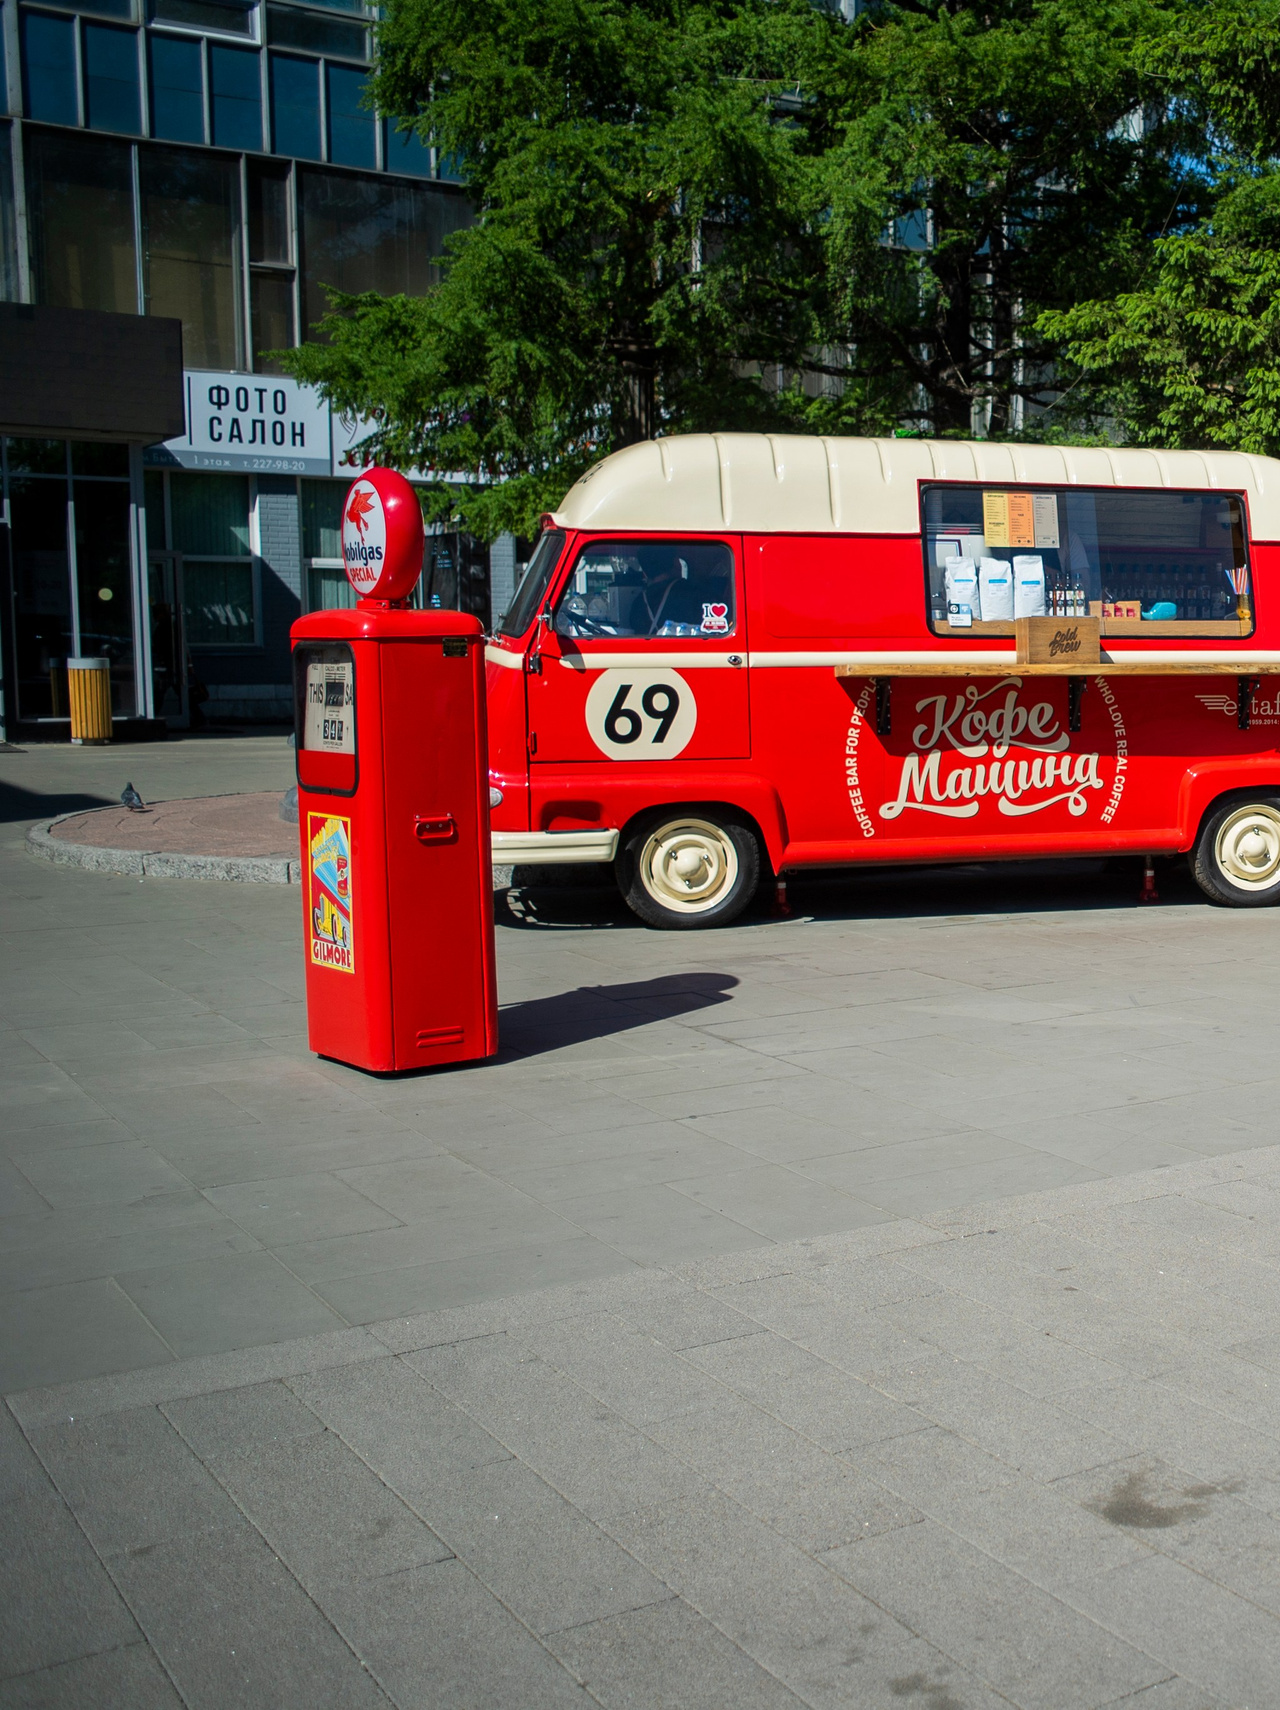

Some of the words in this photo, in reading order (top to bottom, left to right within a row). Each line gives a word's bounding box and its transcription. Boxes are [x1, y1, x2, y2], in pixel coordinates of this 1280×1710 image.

[208, 384, 287, 415] ФОТО
[208, 416, 306, 448] САЛОН
[193, 455, 198, 465] 1
[203, 458, 232, 467] этаж
[252, 458, 306, 471] 227-98-20
[350, 567, 377, 582] SPECIAL
[1049, 640, 1081, 657] Brew
[1053, 626, 1078, 643] Cold
[309, 683, 324, 704] THIS
[1094, 675, 1115, 704] WHO
[604, 683, 680, 744] 69
[912, 676, 1070, 758] Кофе
[1108, 705, 1126, 737] LOVE
[845, 727, 861, 755] FOR
[1116, 739, 1128, 773] REAL
[845, 757, 859, 786] BAR
[879, 749, 1104, 820] Машина
[849, 787, 875, 838] COFFEE
[1100, 775, 1126, 824] COFFEE
[313, 940, 351, 968] GILMORE
